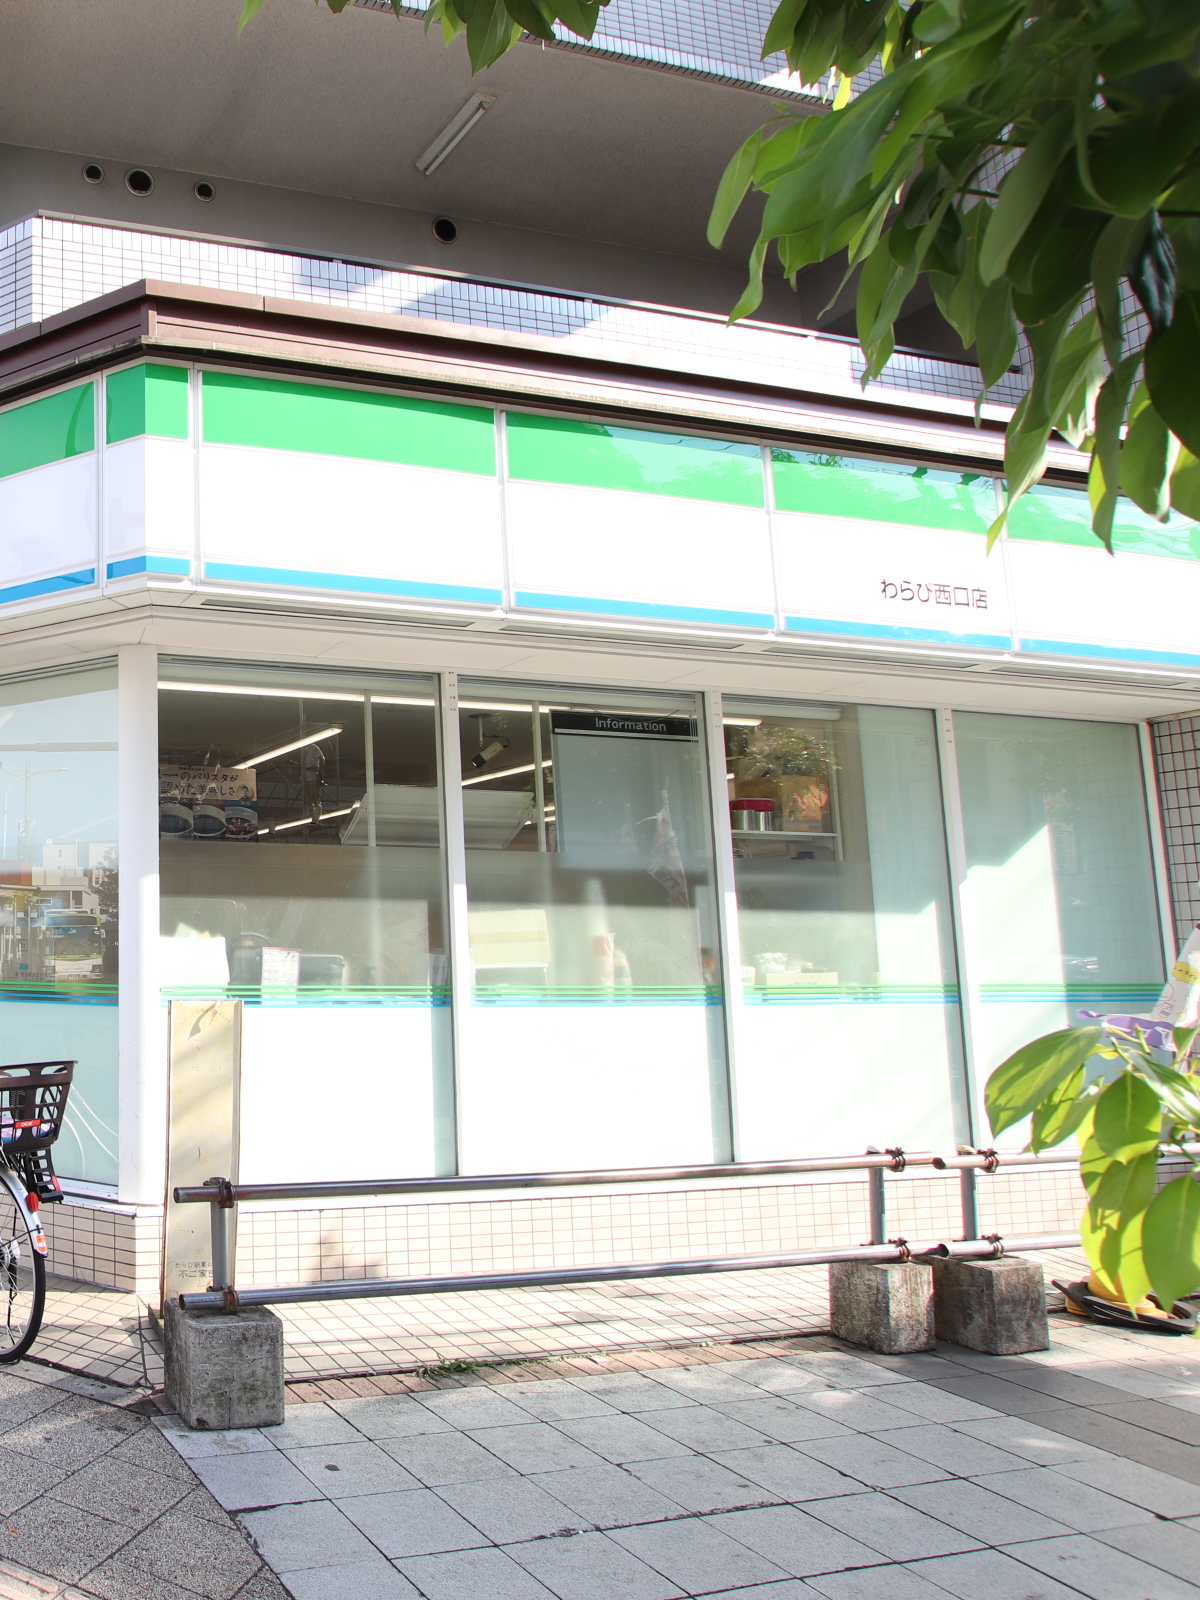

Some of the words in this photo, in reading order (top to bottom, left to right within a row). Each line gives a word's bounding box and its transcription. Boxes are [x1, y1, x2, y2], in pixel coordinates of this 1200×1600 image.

[881, 579, 987, 609] わらび西口店
[595, 717, 667, 732] Information
[159, 771, 239, 784] 一のバリスタが
[160, 780, 236, 796] 認めた美味しさ
